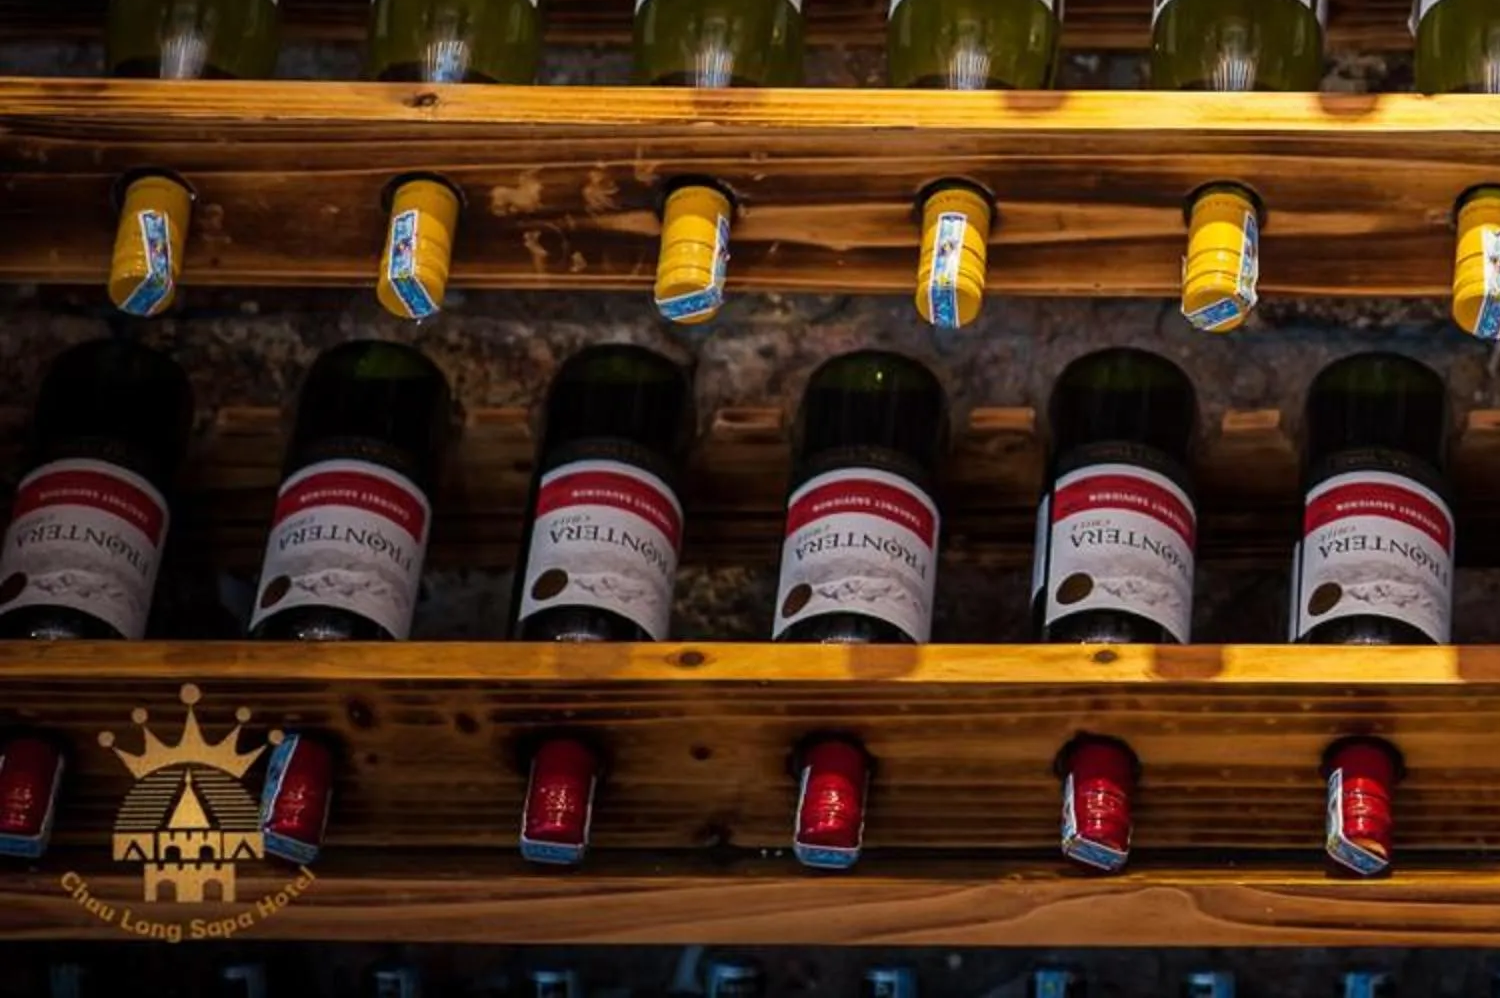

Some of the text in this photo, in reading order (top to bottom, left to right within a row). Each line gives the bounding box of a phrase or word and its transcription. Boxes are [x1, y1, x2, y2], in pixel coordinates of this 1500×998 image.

[279, 527, 413, 572] FRONTERA
[550, 526, 672, 582] RONTERA
[795, 533, 926, 580] FRONTERA
[1070, 529, 1187, 574] RONTERA
